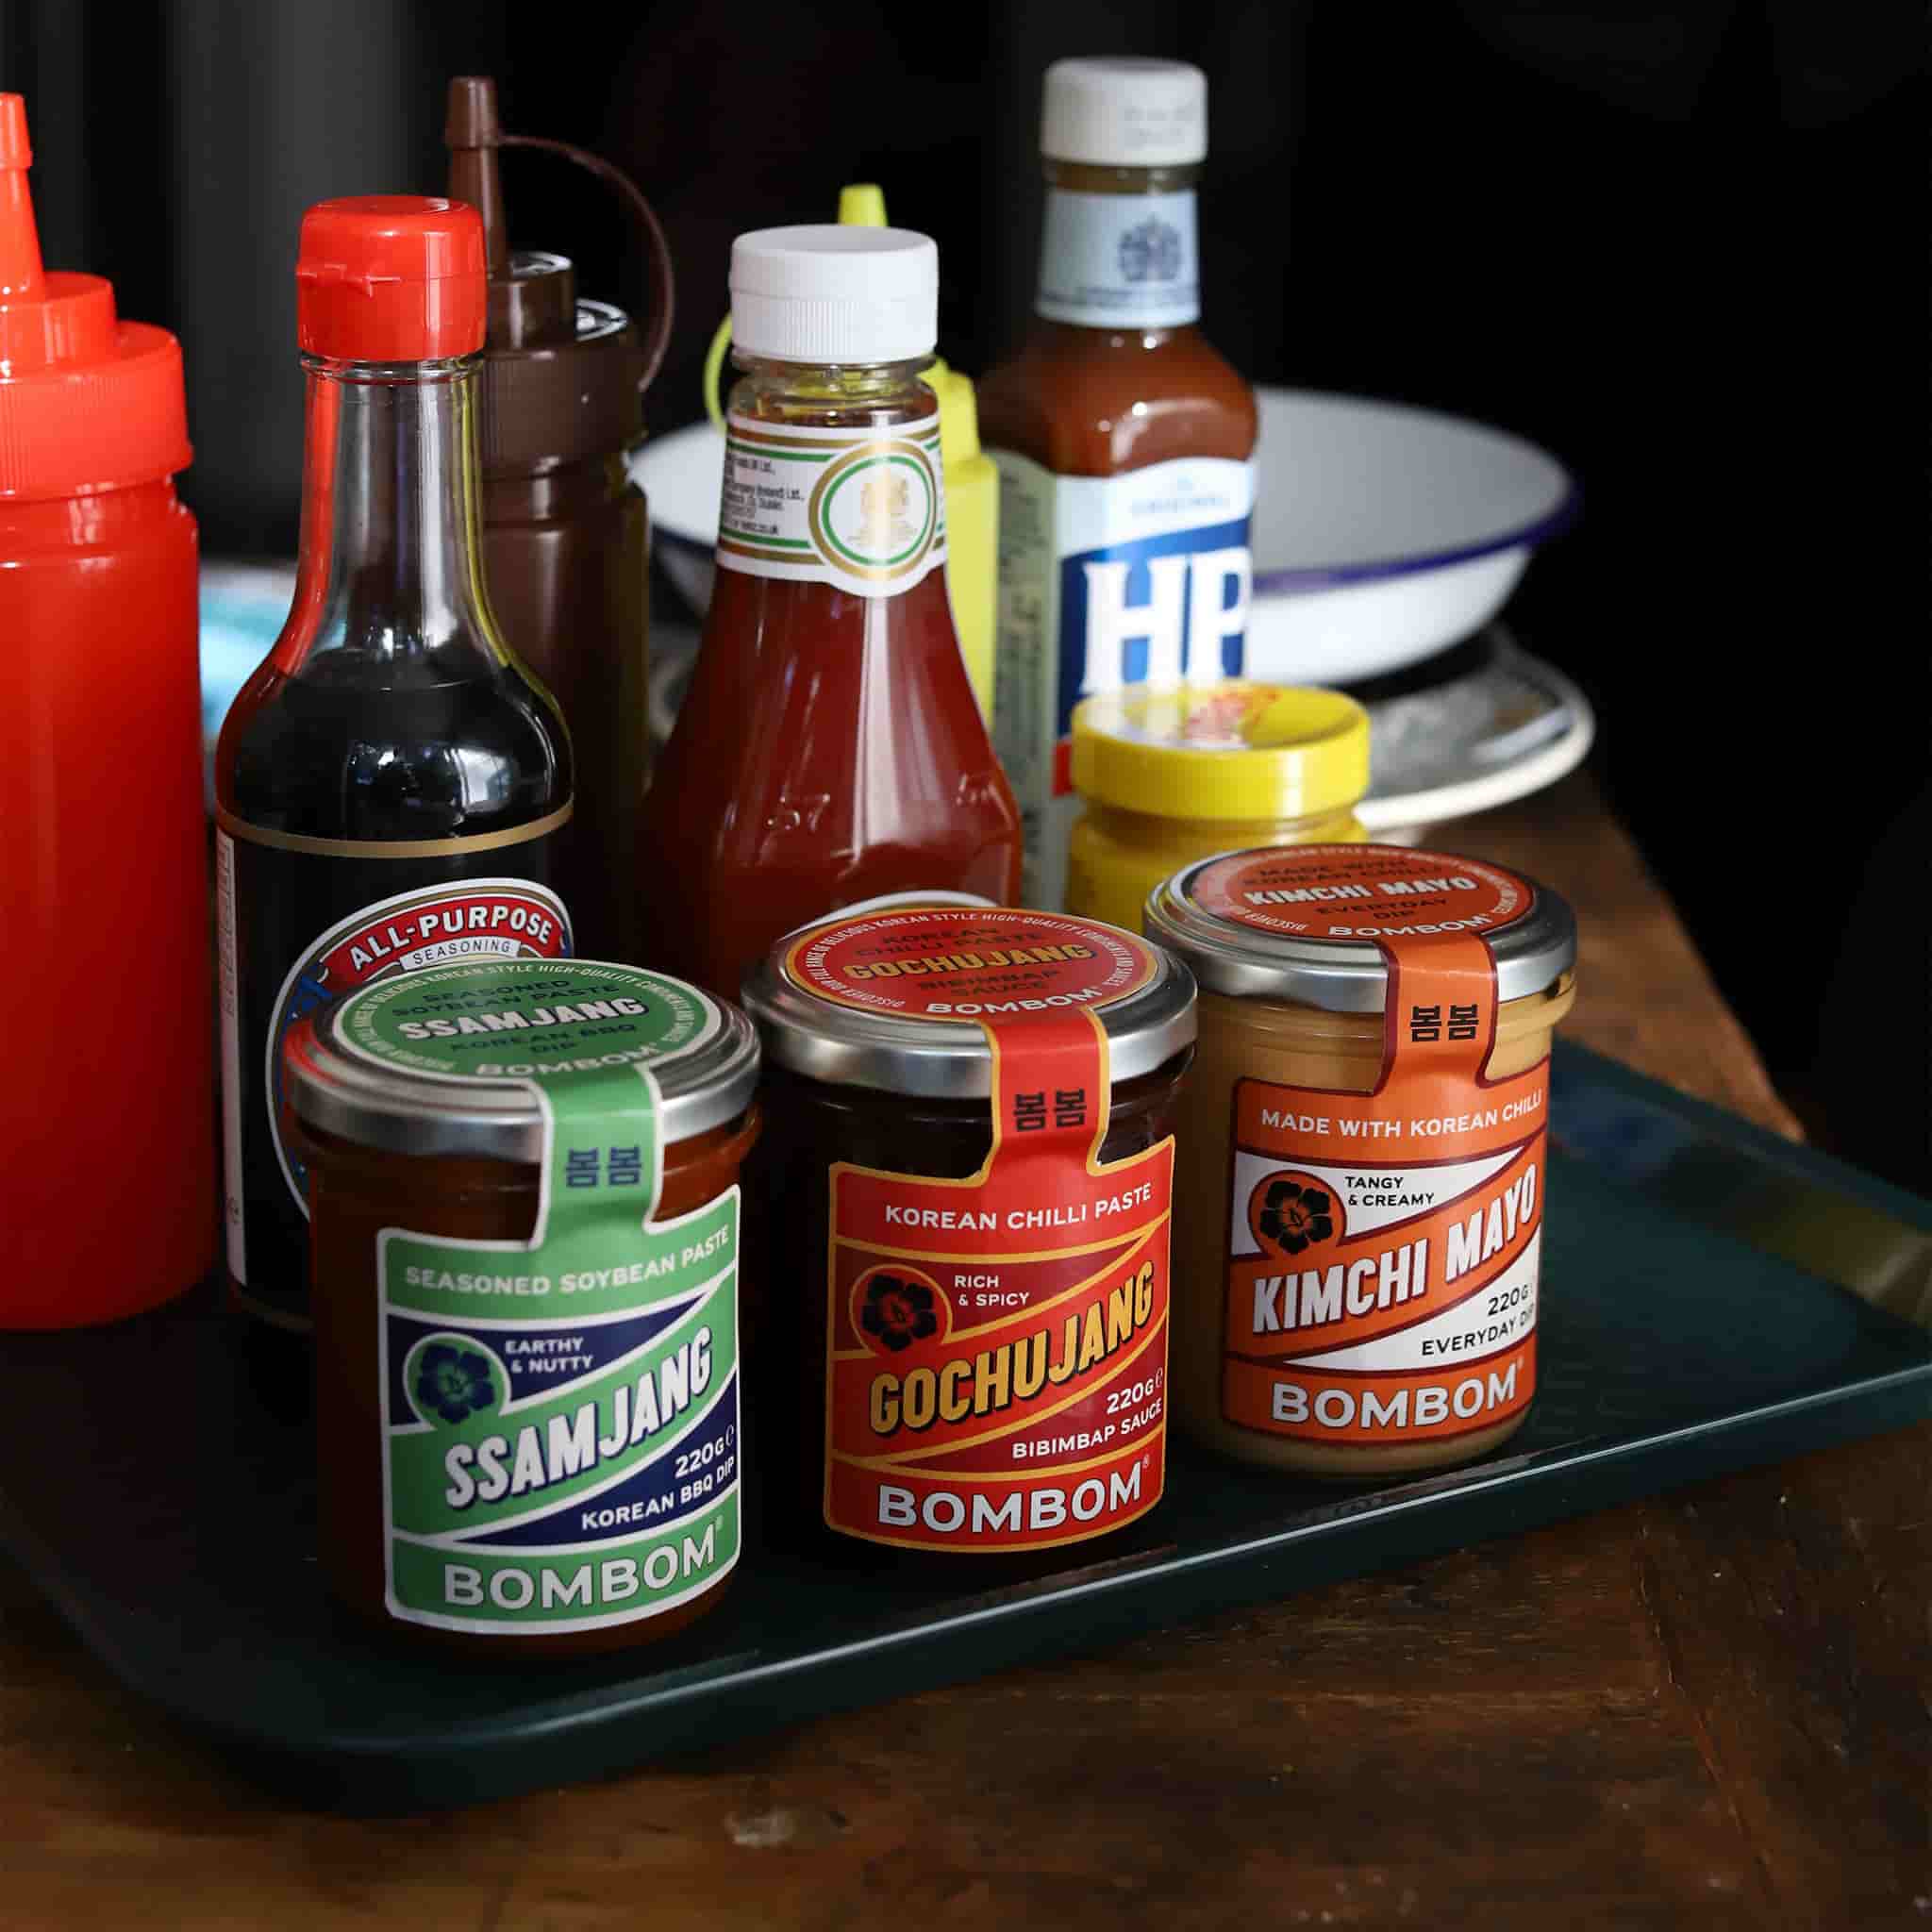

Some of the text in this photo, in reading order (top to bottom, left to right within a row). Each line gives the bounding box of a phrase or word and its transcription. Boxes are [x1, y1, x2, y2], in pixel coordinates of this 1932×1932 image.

[1080, 545, 1251, 695] HP
[1243, 875, 1479, 906] KIMCHI MAYO
[933, 912, 977, 922] STYLE
[349, 903, 553, 971] ALL-PURPOSE
[412, 939, 511, 965] SEASONING
[484, 964, 531, 974] STYLE
[842, 943, 1095, 979] GOCHUJANG
[530, 986, 620, 1000] PASTE
[397, 997, 649, 1040] SSAMJANG
[1409, 1004, 1479, 1042] 봄봄
[1013, 1088, 1088, 1133] 봄봄
[1262, 1089, 1542, 1138] MADE WITH KOREAN CHILLI
[565, 1145, 642, 1189] 봄봄
[1345, 1175, 1404, 1190] TANGY
[885, 1182, 1153, 1231] KOREAN CHILLI PASTE
[1347, 1192, 1435, 1208] & CREAMY
[405, 1224, 730, 1296] SEASONED SOYBEAN PASTE
[1252, 1162, 1538, 1334] KIMCHI MAYO
[954, 1274, 1000, 1289] RICH
[958, 1291, 1030, 1308] & SPICY
[504, 1337, 584, 1355] EARTHY
[869, 1260, 1155, 1435] GOCHUJANG
[1421, 1320, 1515, 1356] EVERYDAY
[510, 1355, 593, 1374] & NUTTY
[444, 1325, 712, 1509] SSAMJANG
[1011, 1398, 1163, 1460] BIBIMBAP SAUCE
[581, 1456, 735, 1531] KOREAN BBQ DIP
